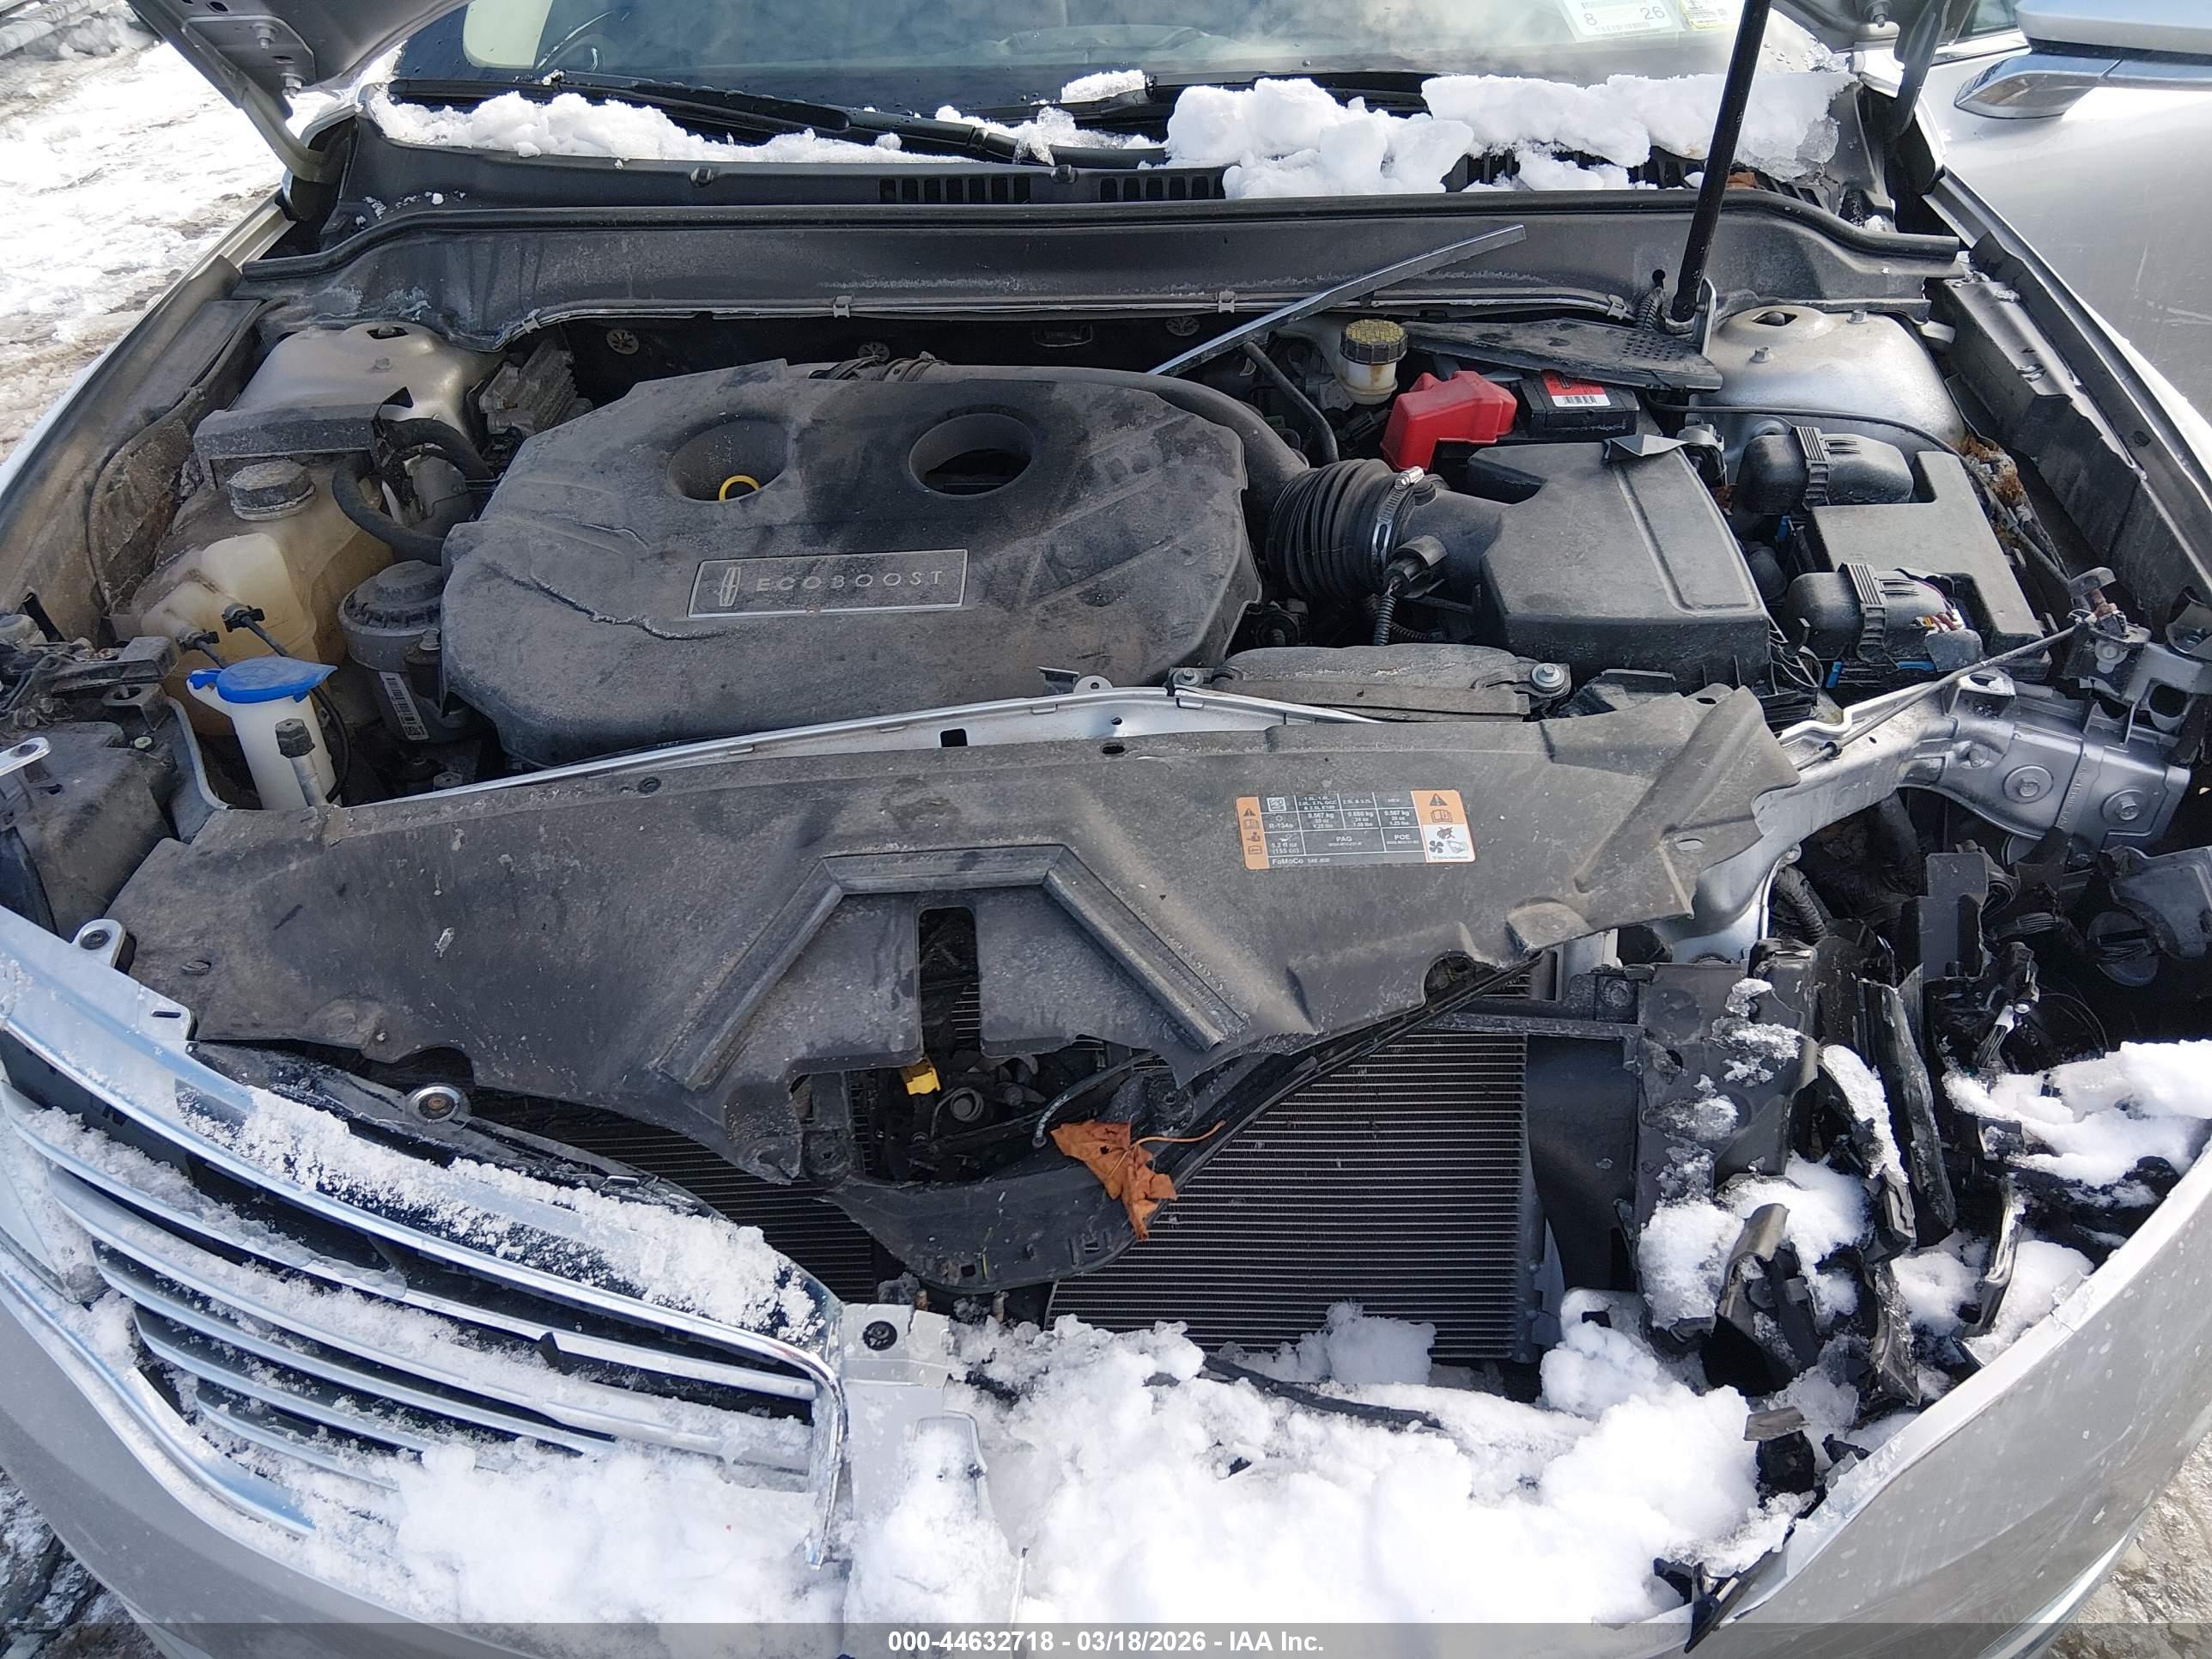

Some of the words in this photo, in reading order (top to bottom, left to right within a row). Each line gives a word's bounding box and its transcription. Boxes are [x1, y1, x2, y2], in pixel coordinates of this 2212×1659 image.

[1583, 13, 1598, 26] 8
[1640, 6, 1666, 20] 26
[756, 570, 943, 592] ECOBOOST
